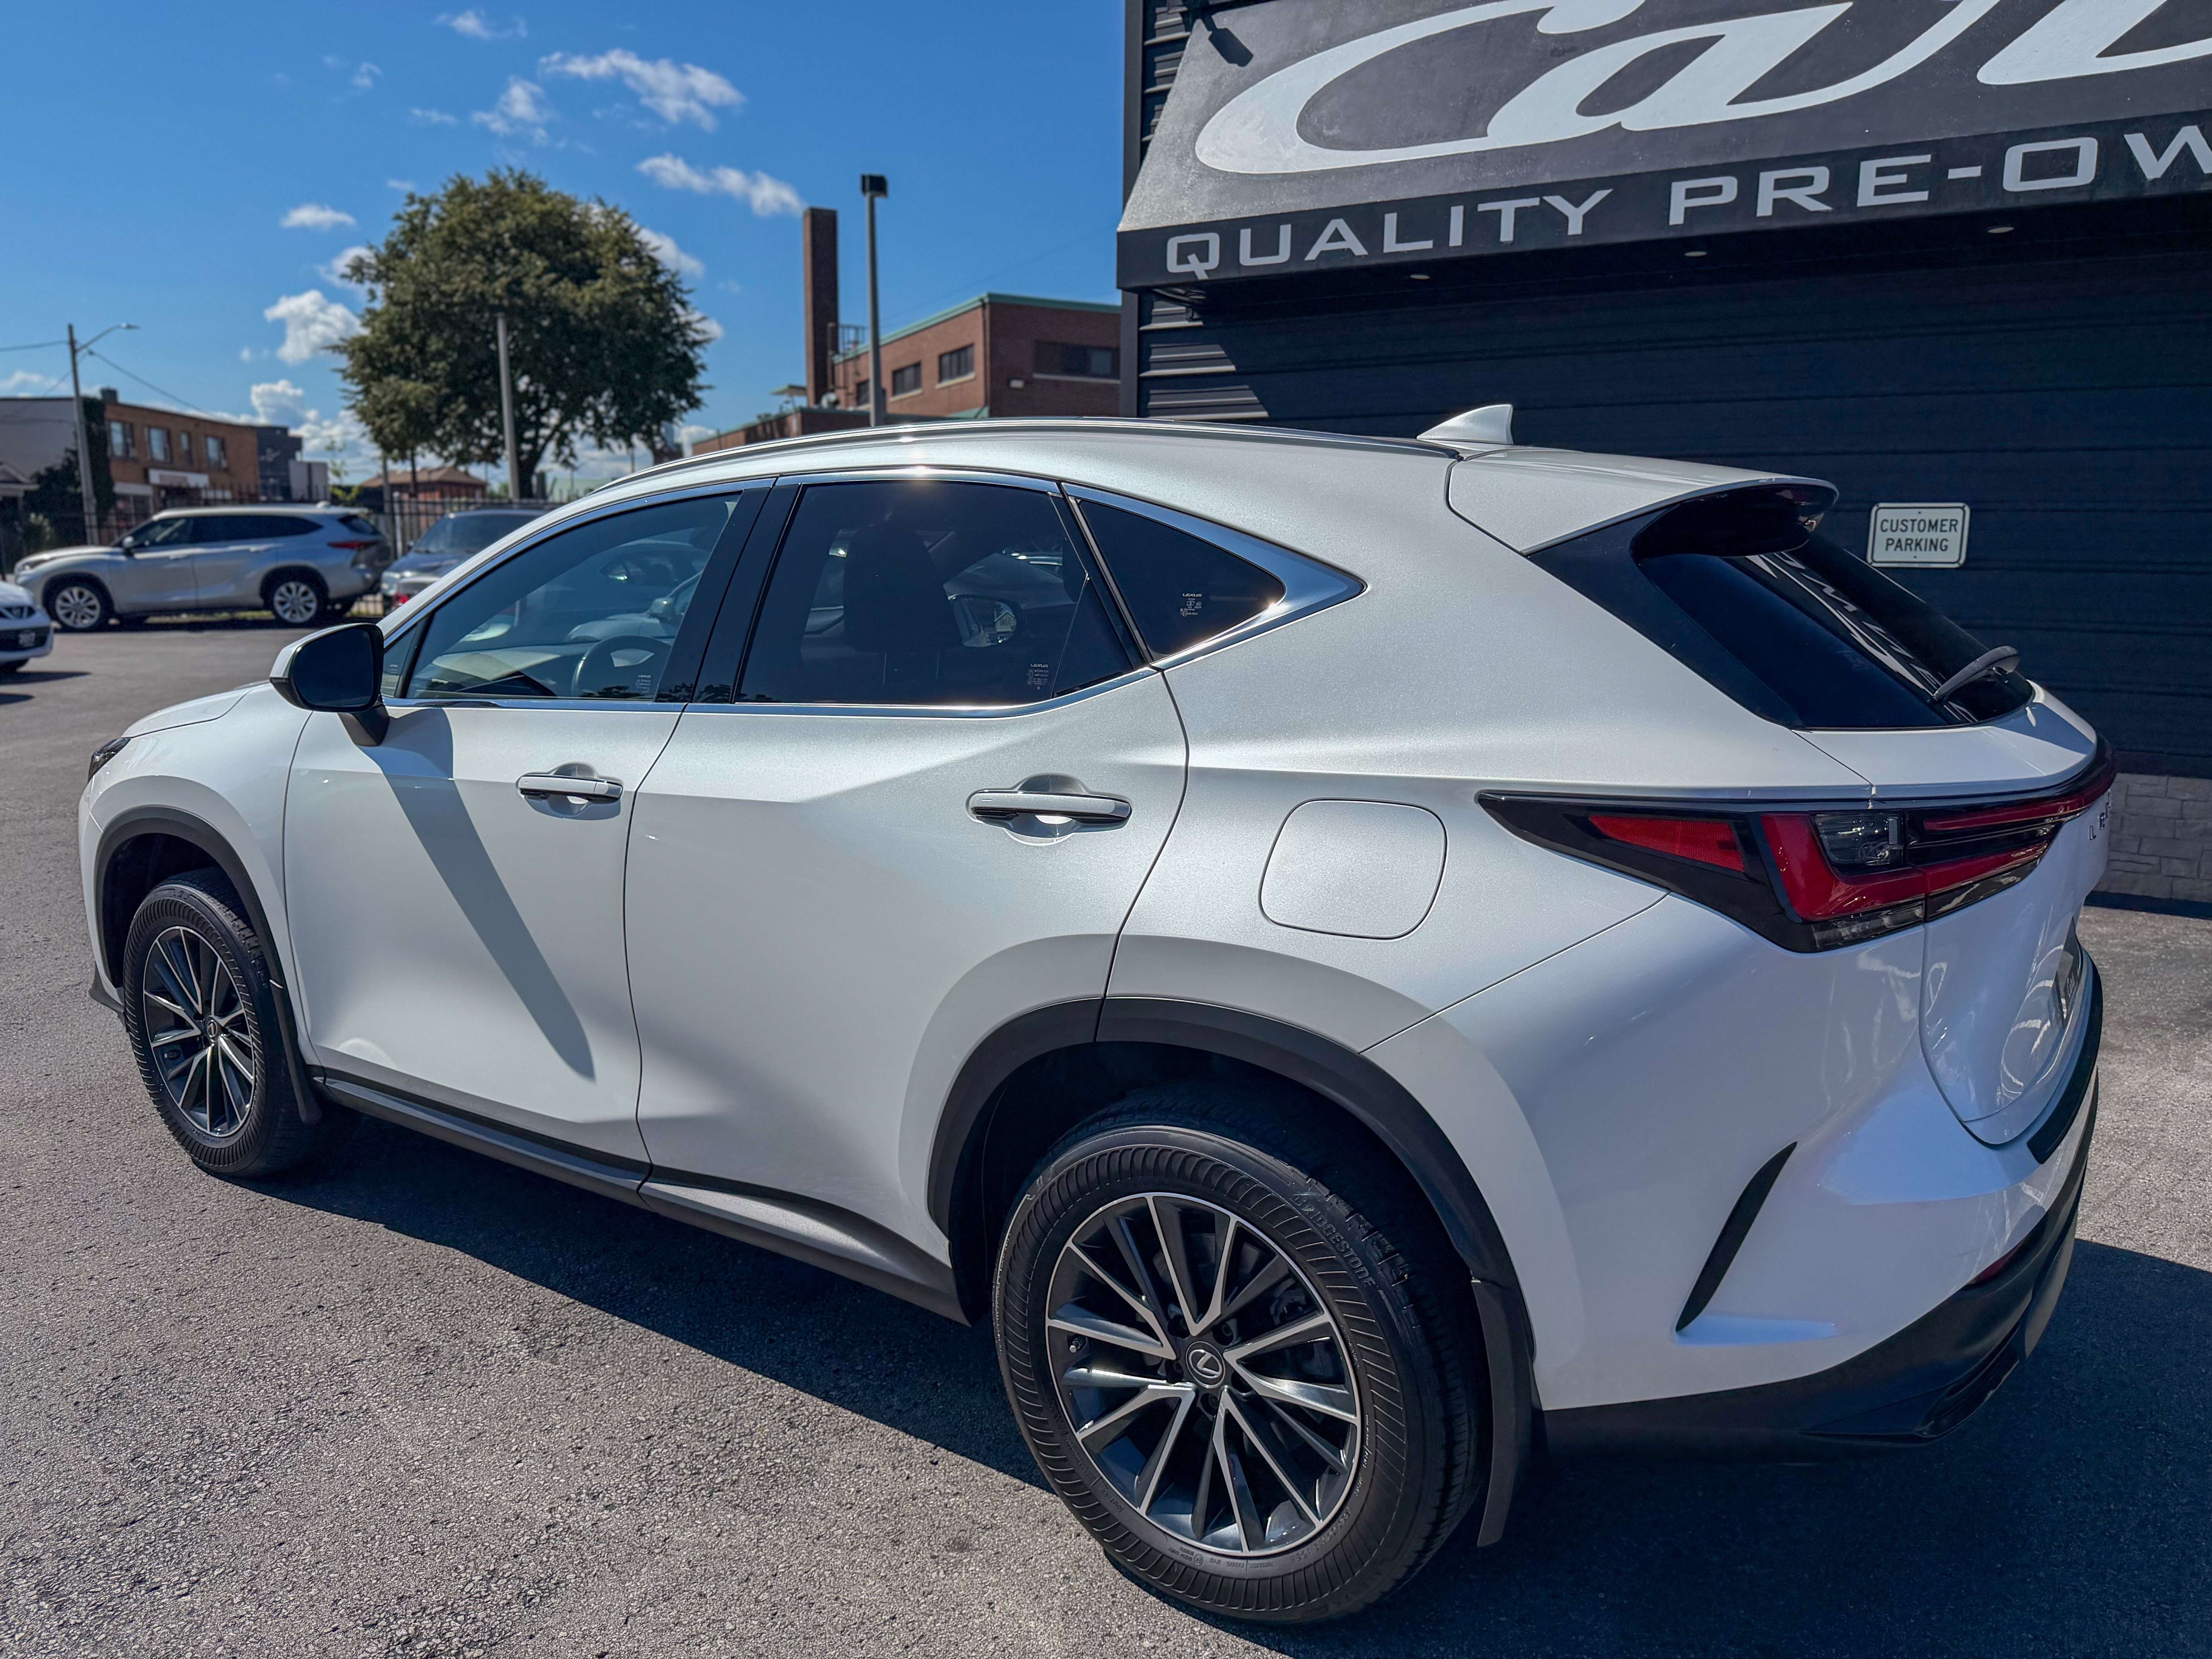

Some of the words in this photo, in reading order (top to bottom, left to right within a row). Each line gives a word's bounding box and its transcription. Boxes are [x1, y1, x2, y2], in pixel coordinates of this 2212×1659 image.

[1166, 188, 1614, 280] QUALITY
[1880, 519, 1958, 533] CUSTOMER
[1884, 538, 1949, 552] PARKING
[1289, 1194, 1376, 1288] BRIDGESTONE
